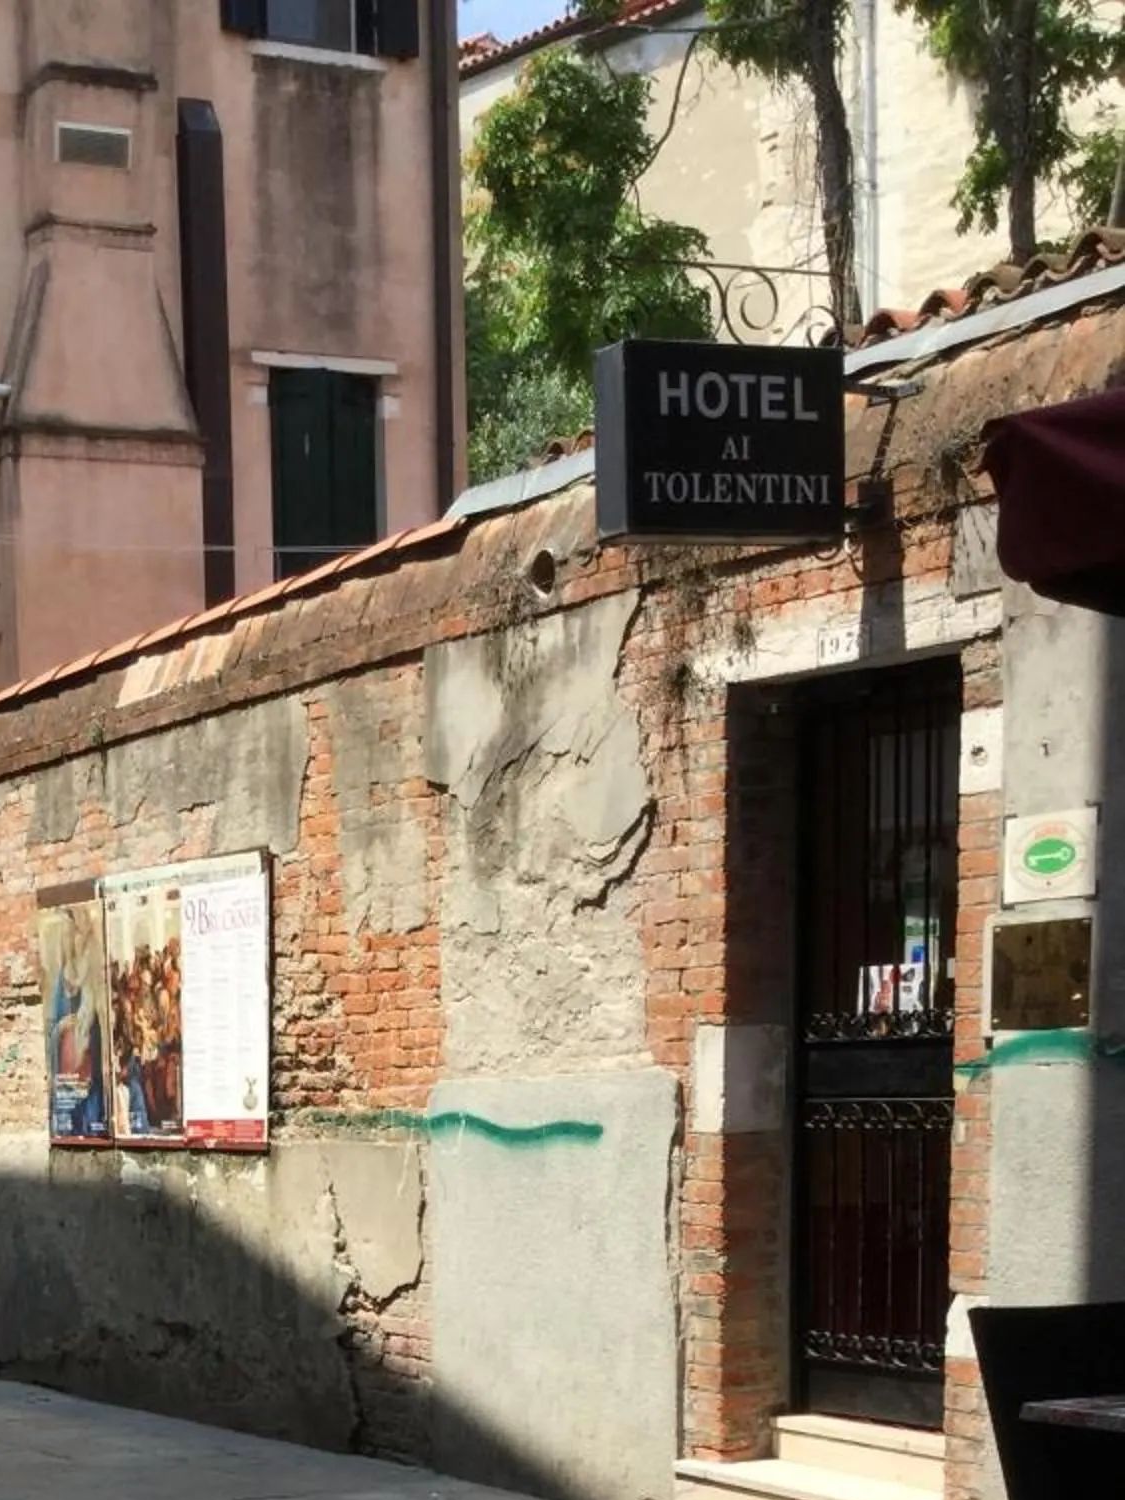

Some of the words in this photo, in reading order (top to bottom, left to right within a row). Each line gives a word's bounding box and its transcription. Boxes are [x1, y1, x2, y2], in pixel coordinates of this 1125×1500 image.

[658, 371, 819, 421] HOTEL
[721, 435, 751, 461] AI
[643, 471, 831, 505] TOLENTINI
